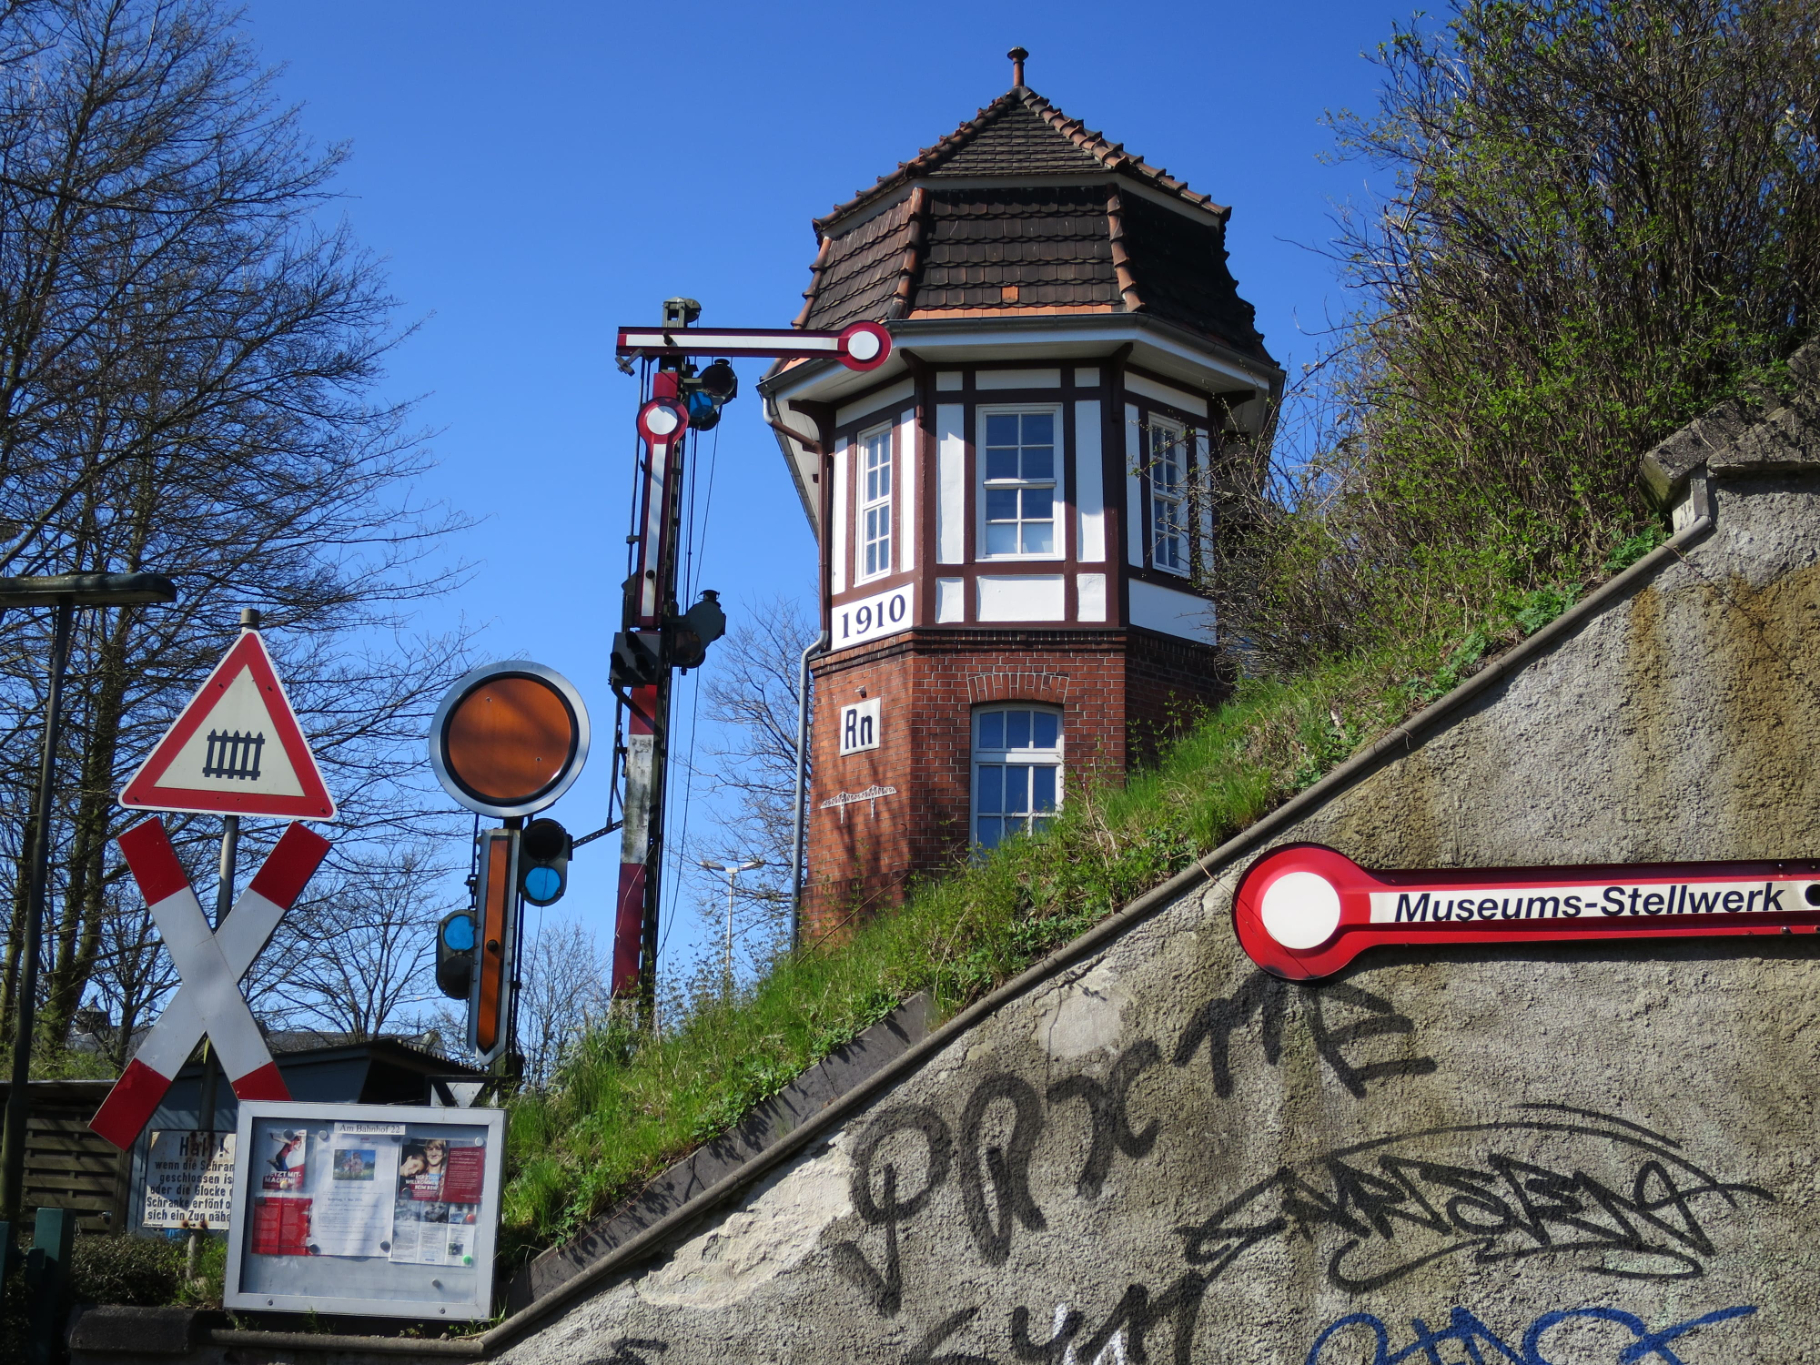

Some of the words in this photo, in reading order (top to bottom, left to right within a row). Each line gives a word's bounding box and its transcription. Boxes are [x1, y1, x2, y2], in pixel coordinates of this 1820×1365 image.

[842, 593, 906, 640] 1910
[845, 708, 873, 750] Rn
[1394, 882, 1785, 923] Museums-Stellwerk
[340, 1124, 354, 1132] Am
[356, 1124, 389, 1133] Bahnhof
[154, 1161, 179, 1170] wenn
[183, 1160, 197, 1170] die
[159, 1173, 219, 1184] geschlossen
[150, 1184, 172, 1195] oder
[176, 1184, 190, 1195] die
[194, 1185, 226, 1195] Glocke
[146, 1197, 190, 1208] Schranke
[192, 1198, 223, 1209] ertönt
[147, 1210, 168, 1221] sich
[170, 1210, 185, 1221] ein
[188, 1210, 205, 1223] Zug
